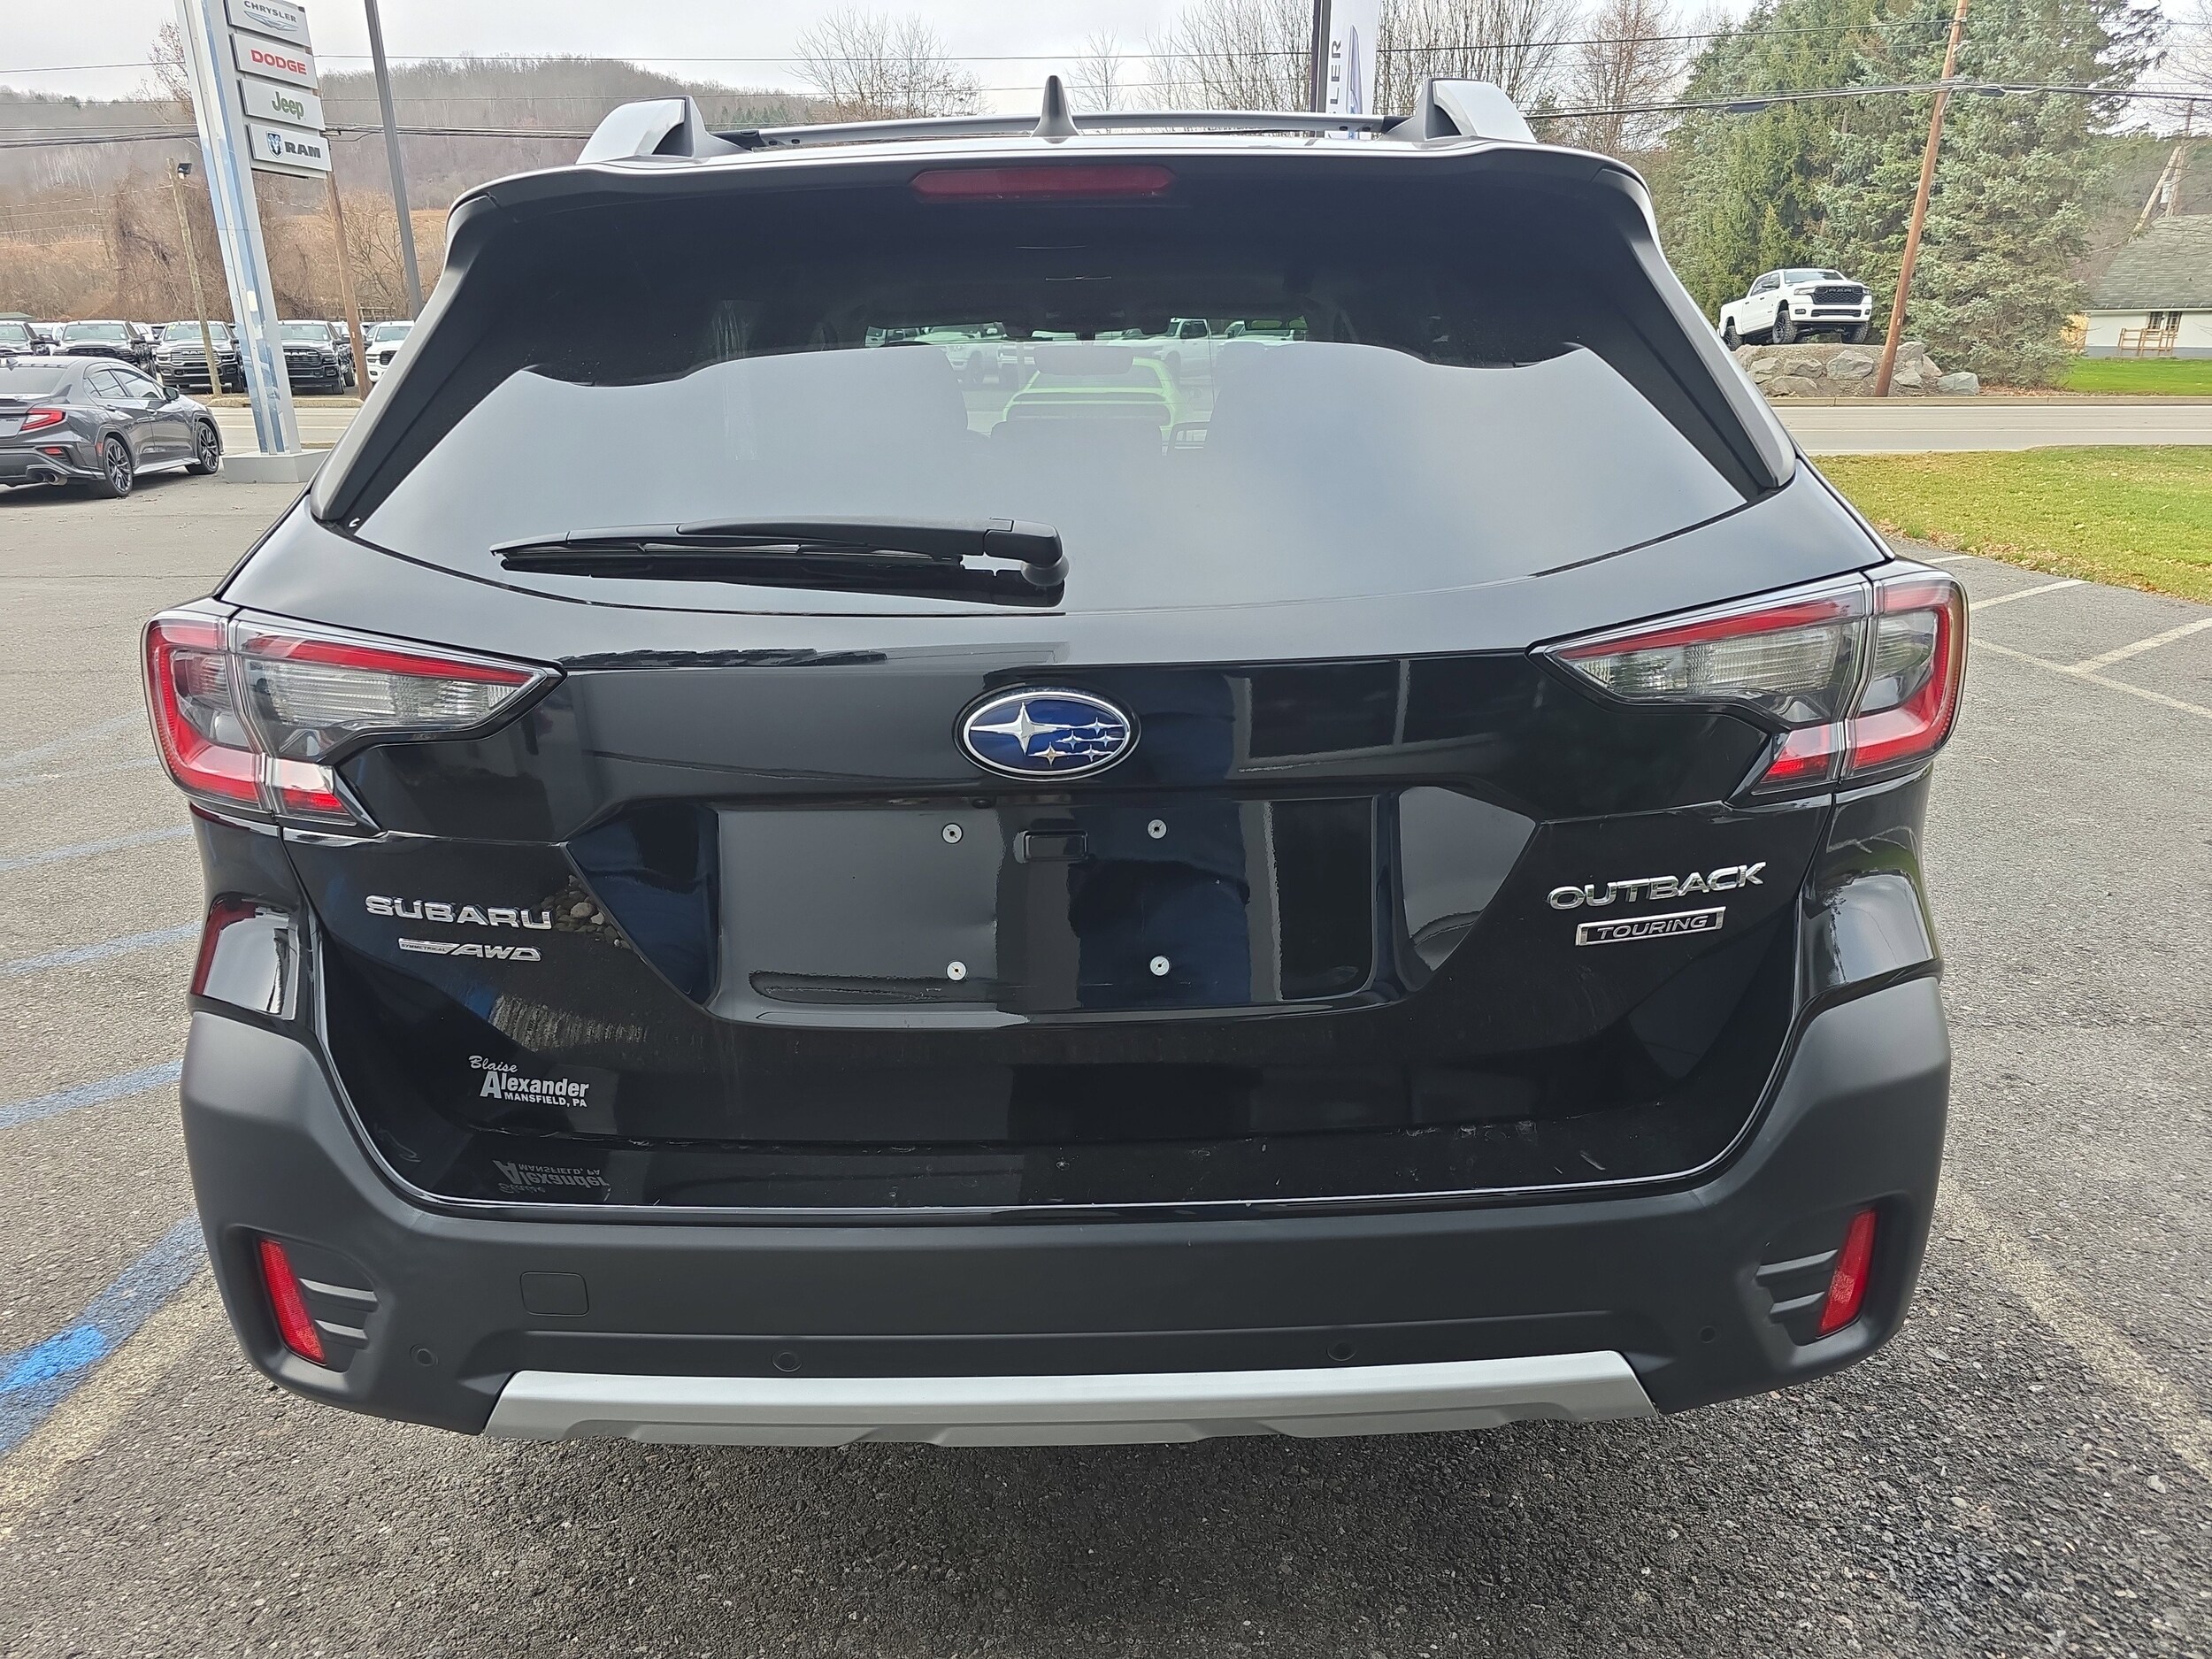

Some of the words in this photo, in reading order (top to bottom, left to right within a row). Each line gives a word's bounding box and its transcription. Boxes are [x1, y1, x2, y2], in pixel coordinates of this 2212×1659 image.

[244, 0, 297, 23] CHRYSLER
[250, 49, 307, 75] DODGE
[1329, 40, 1341, 113] LER
[272, 91, 304, 120] Jeep
[285, 141, 321, 159] RAM
[1548, 861, 1767, 910] OUTBACK
[365, 895, 553, 930] SUBARU
[1596, 915, 1709, 940] TOURING
[401, 943, 448, 952] SYMMETRICAL
[450, 943, 542, 962] AWD
[468, 1055, 518, 1073] Blaise
[480, 1071, 590, 1099] Alexander
[504, 1091, 571, 1108] MANSFIELD,
[572, 1098, 588, 1108] PA
